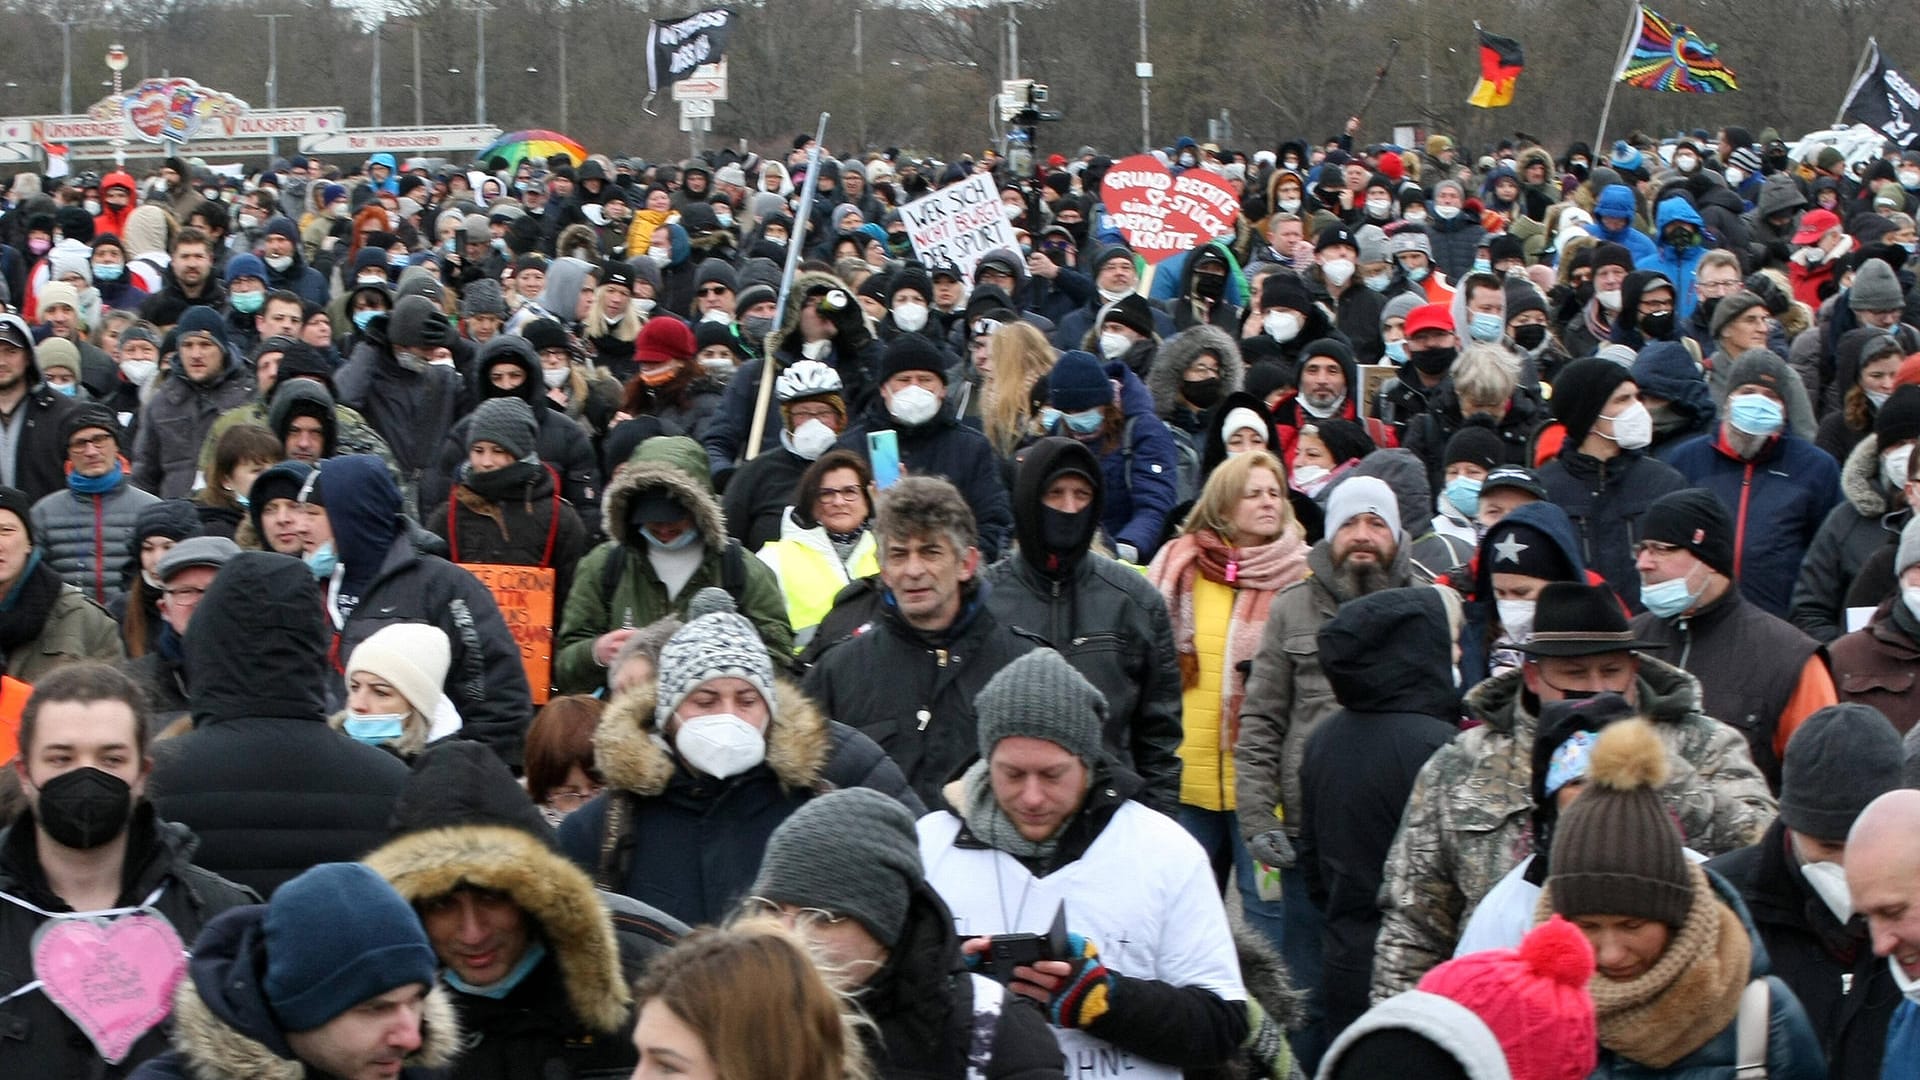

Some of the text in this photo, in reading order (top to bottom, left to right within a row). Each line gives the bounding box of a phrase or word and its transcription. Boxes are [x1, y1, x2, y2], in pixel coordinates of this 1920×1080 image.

[221, 115, 305, 136] VOLKSFEST
[907, 179, 989, 228] WER SICH
[1104, 171, 1240, 216] GRUND RECHTE
[1120, 197, 1172, 218] einer
[914, 199, 1002, 248] NICHT BEWEGT
[1130, 230, 1198, 250] KRATIE
